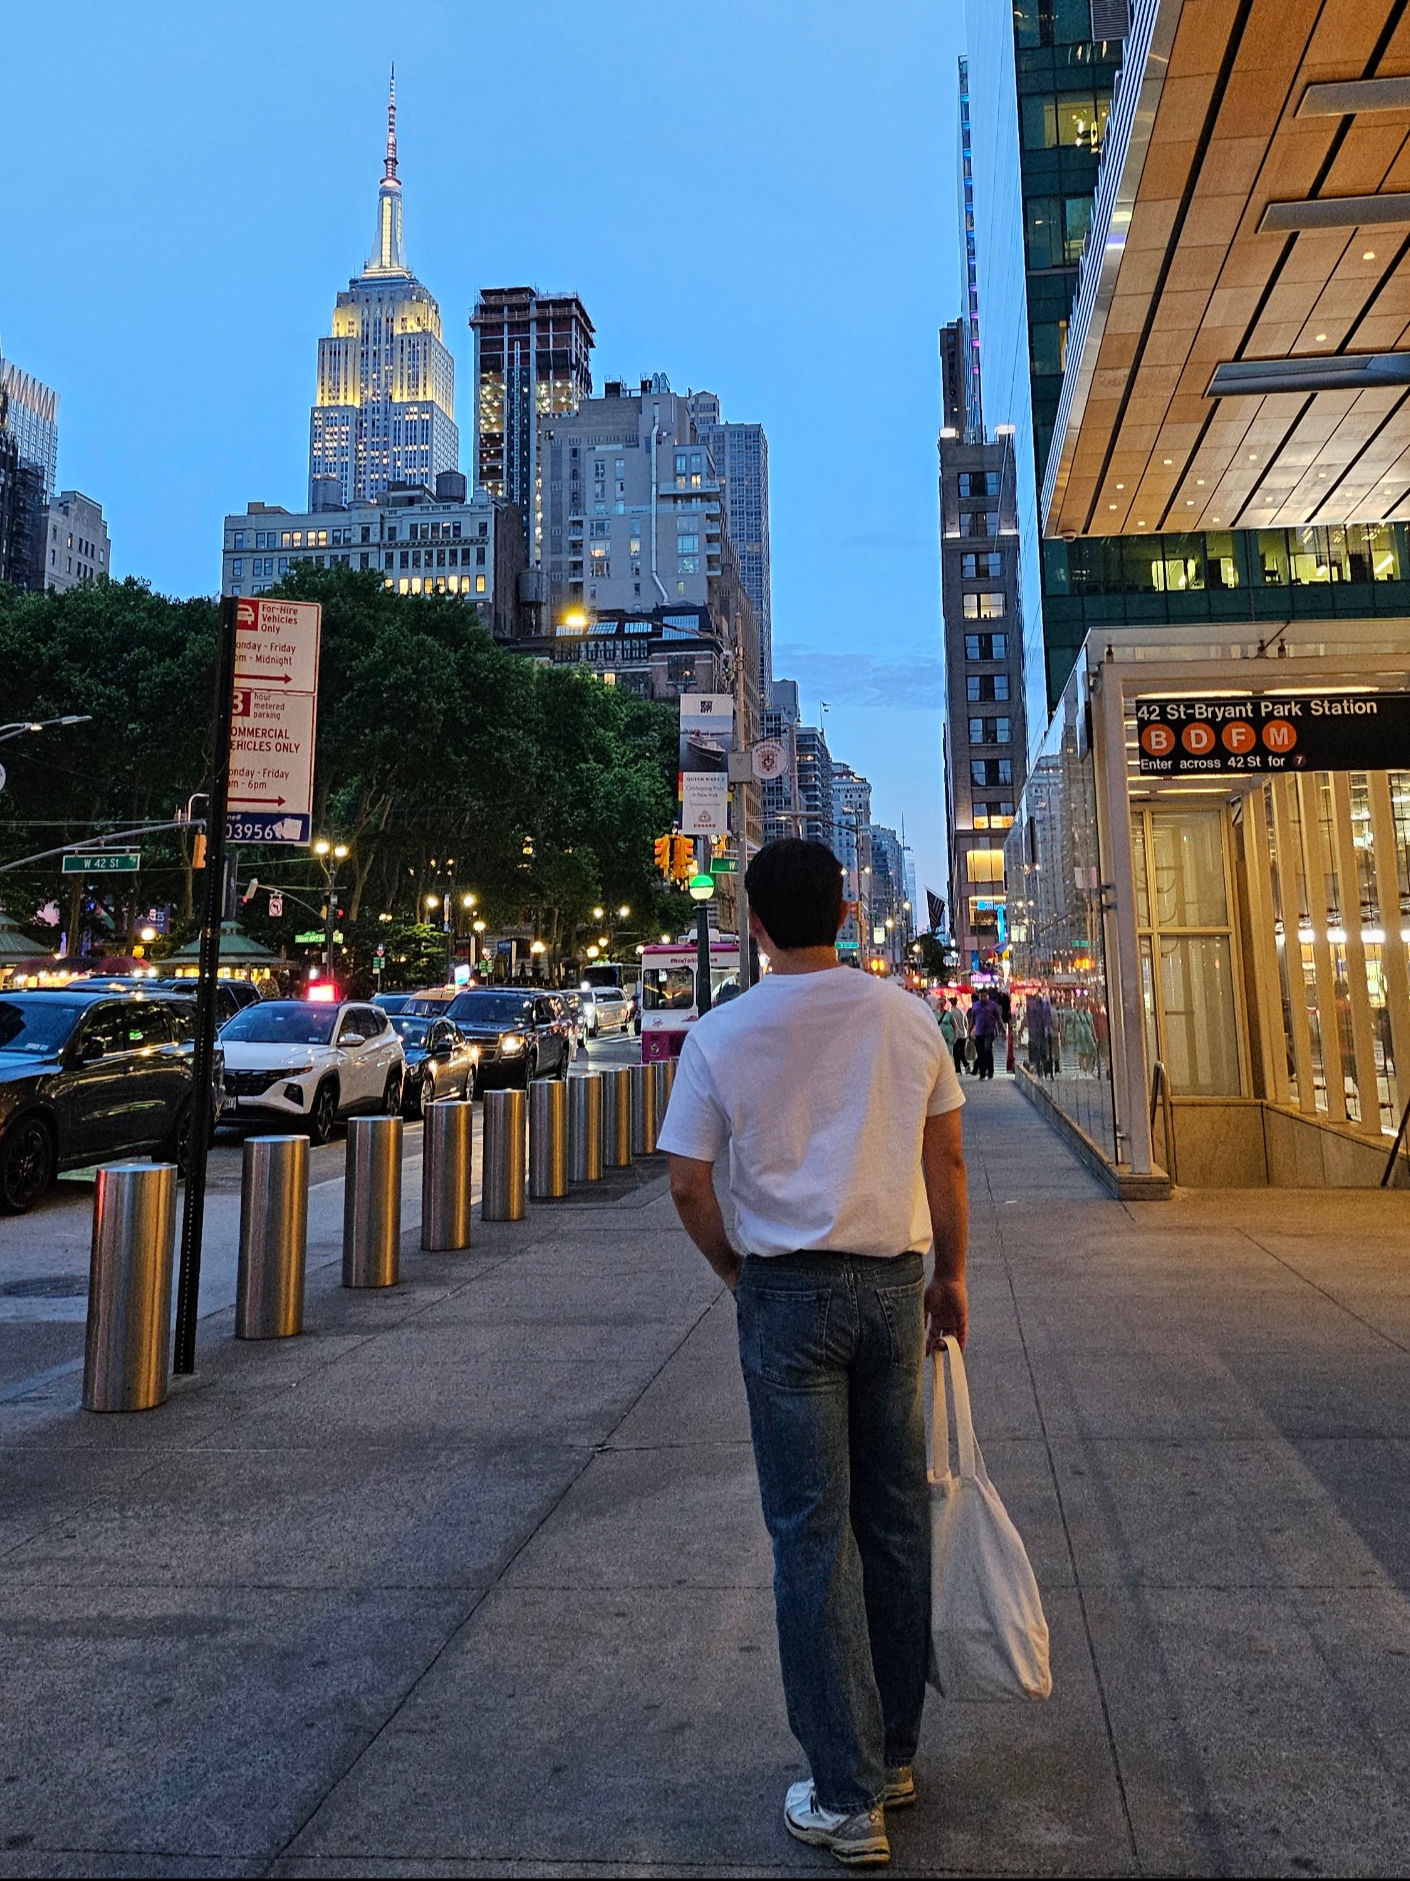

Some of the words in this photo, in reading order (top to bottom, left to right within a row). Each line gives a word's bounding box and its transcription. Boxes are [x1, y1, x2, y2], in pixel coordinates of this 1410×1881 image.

[262, 604, 298, 615] For-Hire
[262, 614, 298, 624] Vehicles
[261, 624, 280, 634] Only
[236, 641, 262, 652] onday
[270, 642, 296, 654] Friday
[256, 654, 292, 666] Midnight
[254, 692, 272, 700] hour
[254, 702, 285, 710] metered
[1138, 705, 1160, 720] 42
[1166, 702, 1254, 722] St-Bryant
[1260, 701, 1302, 717] Park
[1310, 699, 1377, 716] Station
[254, 711, 281, 720] parking
[230, 726, 290, 739] OMMERCIAL
[1150, 730, 1168, 749] B
[1190, 730, 1208, 748] D
[1232, 728, 1246, 747] F
[1269, 727, 1289, 745] M
[230, 740, 272, 752] EHICLES
[275, 742, 300, 753] ONLY
[1140, 759, 1173, 770] Enter
[1180, 759, 1221, 769] across
[1228, 756, 1244, 768] 42
[1247, 756, 1261, 767] St
[1268, 755, 1285, 767] for
[1296, 756, 1302, 765] 7
[228, 768, 255, 778] onday
[263, 768, 290, 780] Friday
[248, 780, 267, 790] 6pm
[84, 860, 90, 868] W
[94, 858, 106, 868] 42
[110, 858, 119, 868] St
